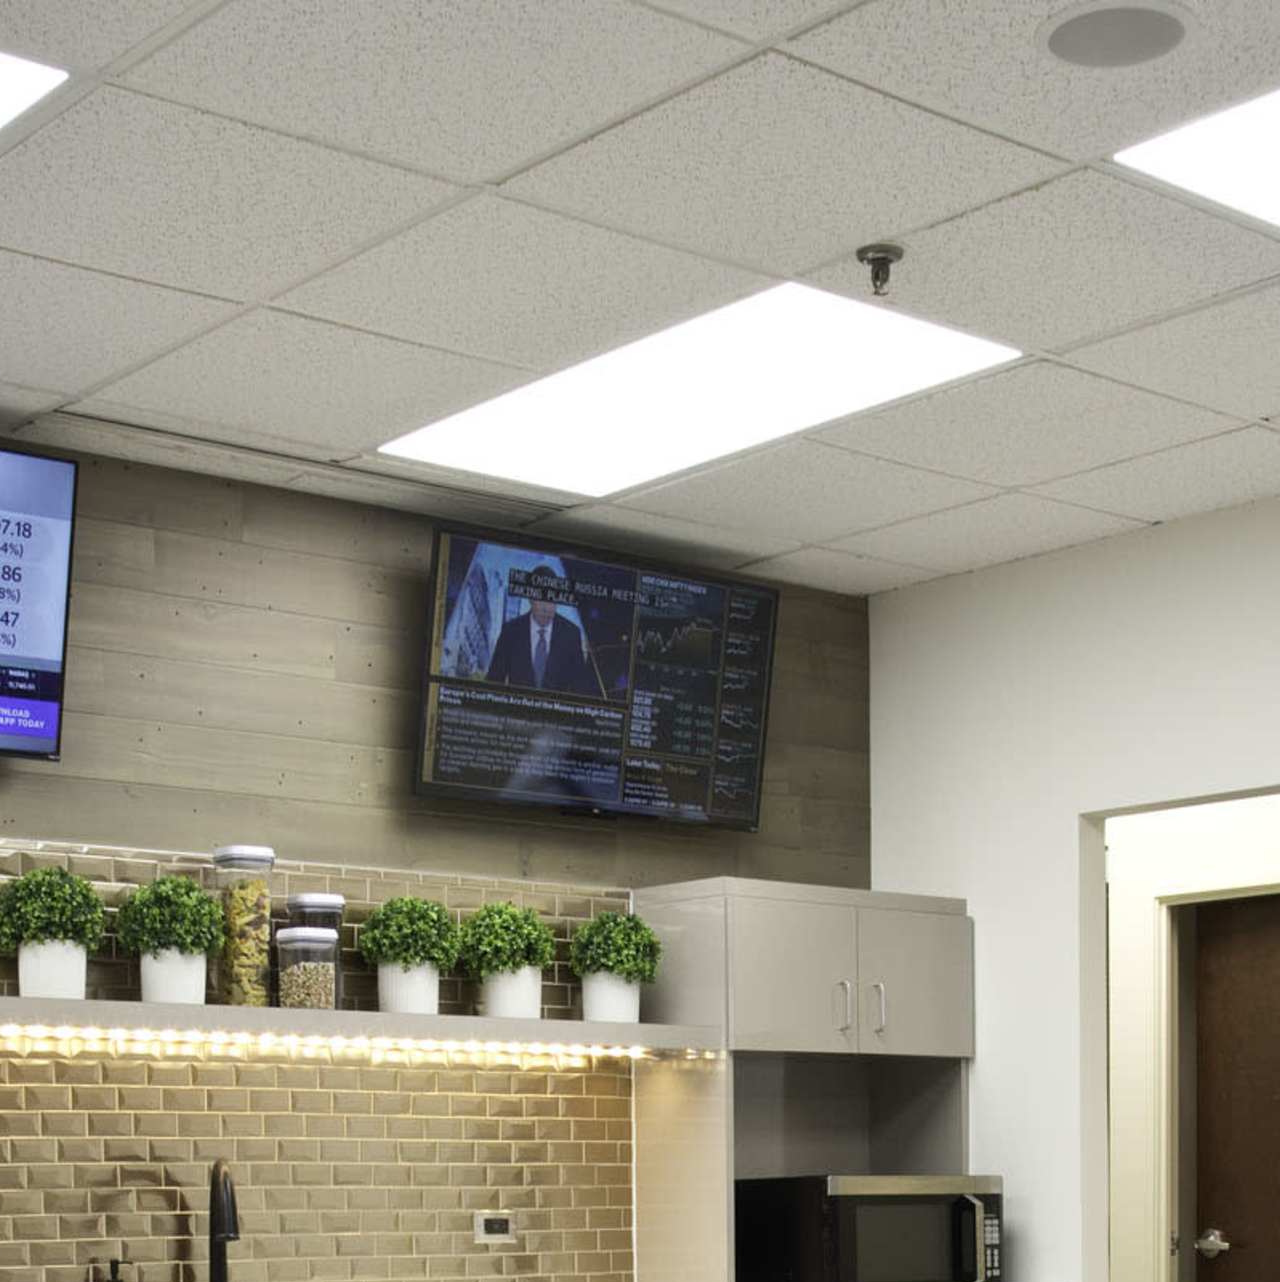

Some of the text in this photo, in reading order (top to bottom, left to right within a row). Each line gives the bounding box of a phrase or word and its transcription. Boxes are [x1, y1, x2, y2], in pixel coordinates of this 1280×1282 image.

[575, 582, 608, 597] RUSSIA
[611, 588, 650, 605] MEETING
[16, 718, 45, 729] TODAY
